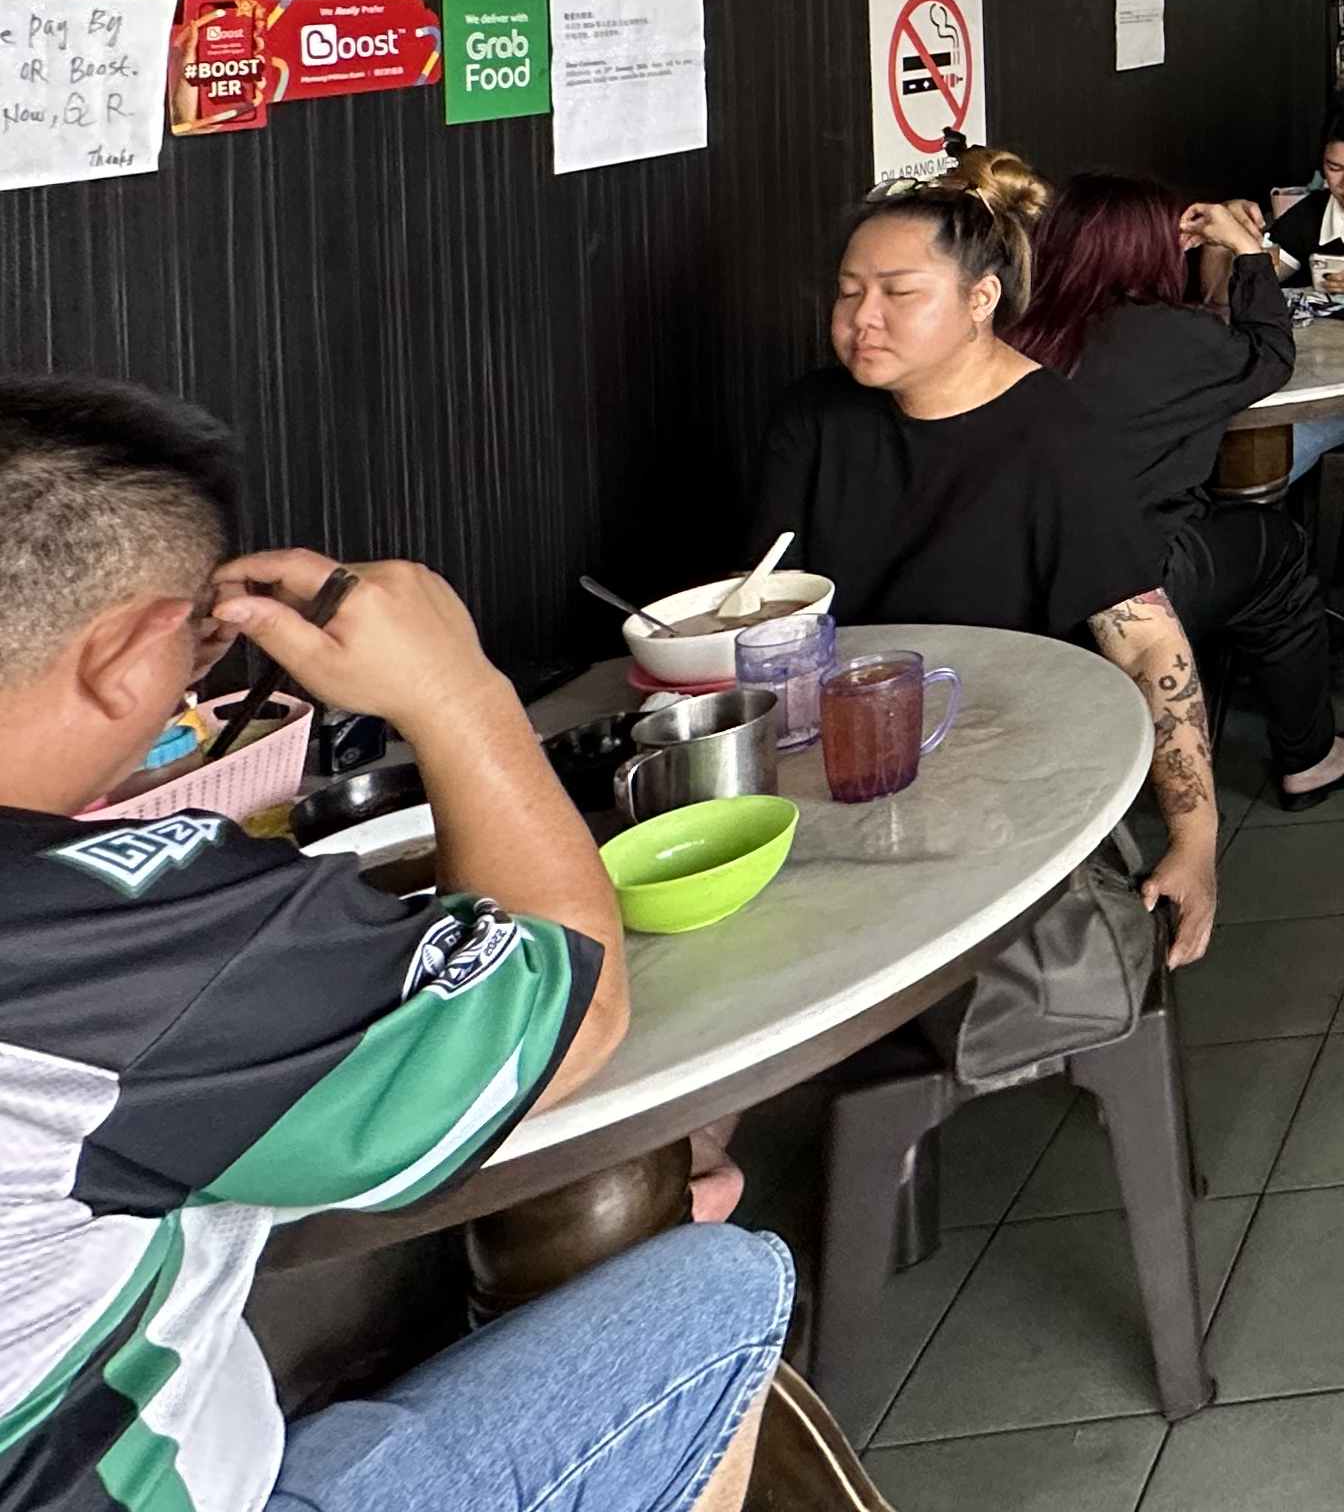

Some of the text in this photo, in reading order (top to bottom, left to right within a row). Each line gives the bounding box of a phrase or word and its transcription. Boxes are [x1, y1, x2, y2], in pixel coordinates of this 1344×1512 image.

[510, 13, 529, 23] with
[465, 28, 529, 61] Grab
[184, 59, 260, 80] #BOOST
[465, 58, 530, 92] Food
[208, 80, 242, 98] JER
[88, 145, 135, 168] Thanks
